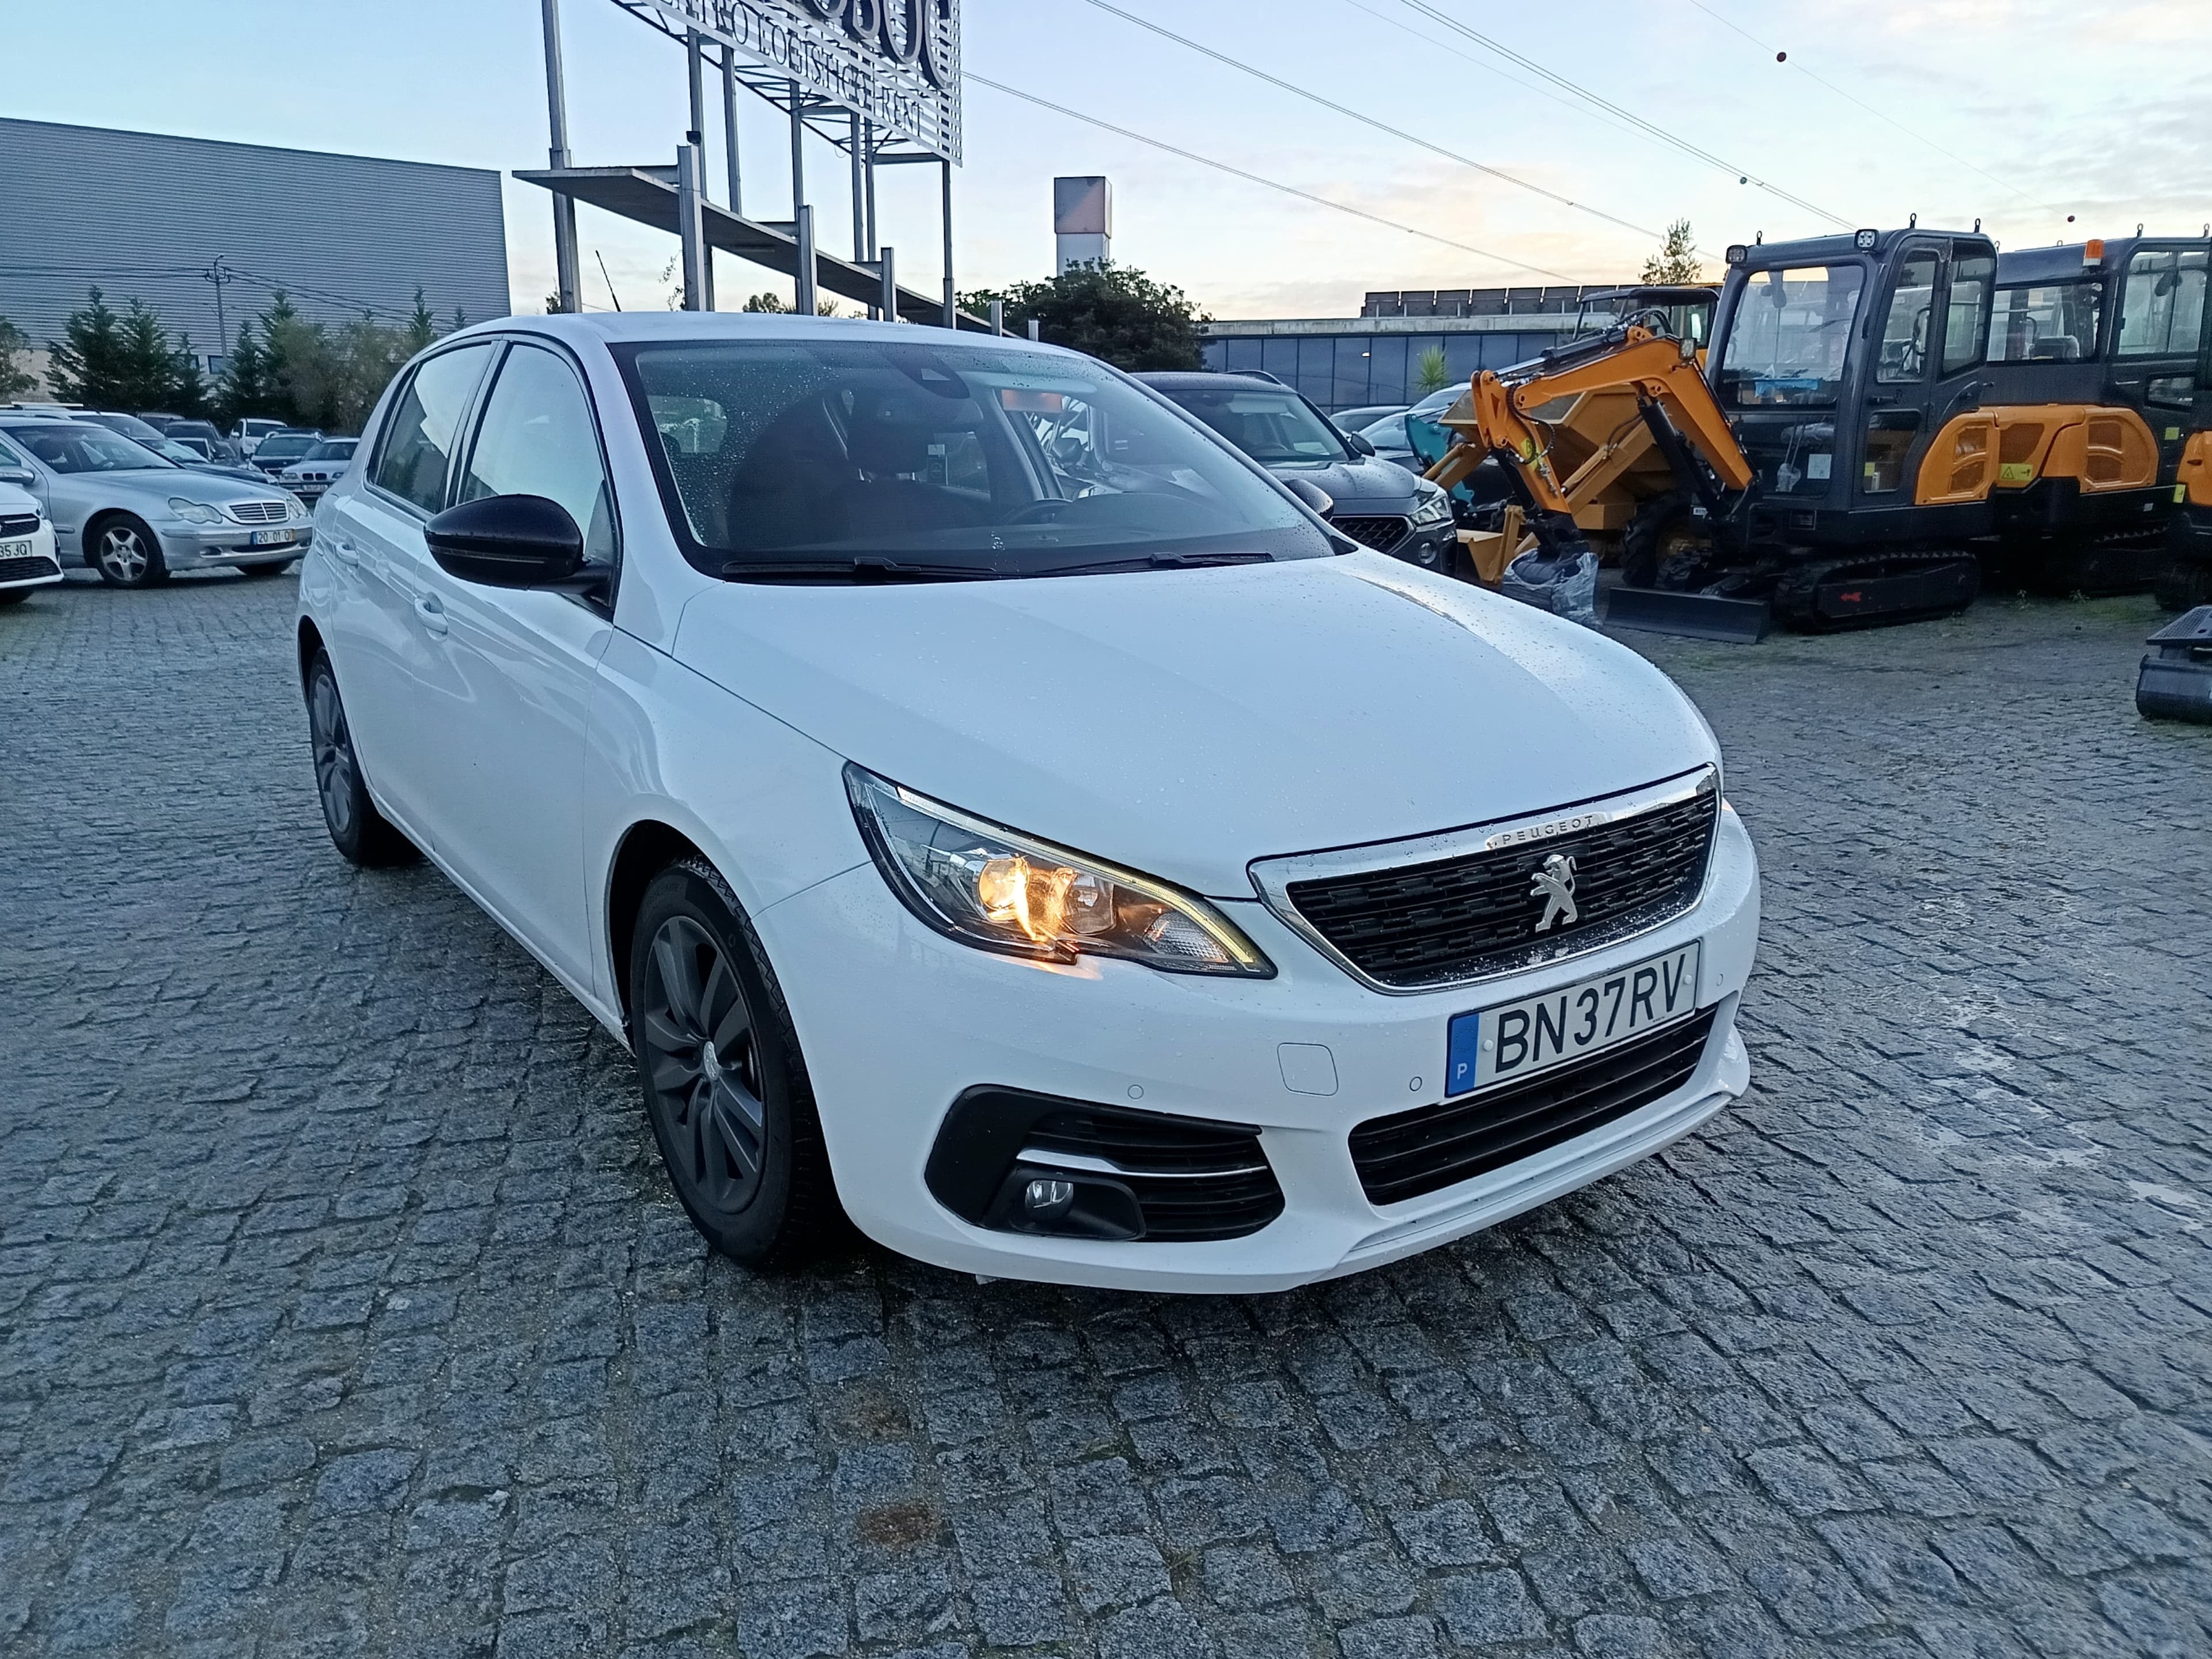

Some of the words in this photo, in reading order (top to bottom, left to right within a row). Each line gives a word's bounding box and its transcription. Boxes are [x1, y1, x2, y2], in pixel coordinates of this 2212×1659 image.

[882, 86, 923, 137] RENT
[1502, 816, 1592, 844] PEUGEOT
[1457, 1062, 1468, 1080] P
